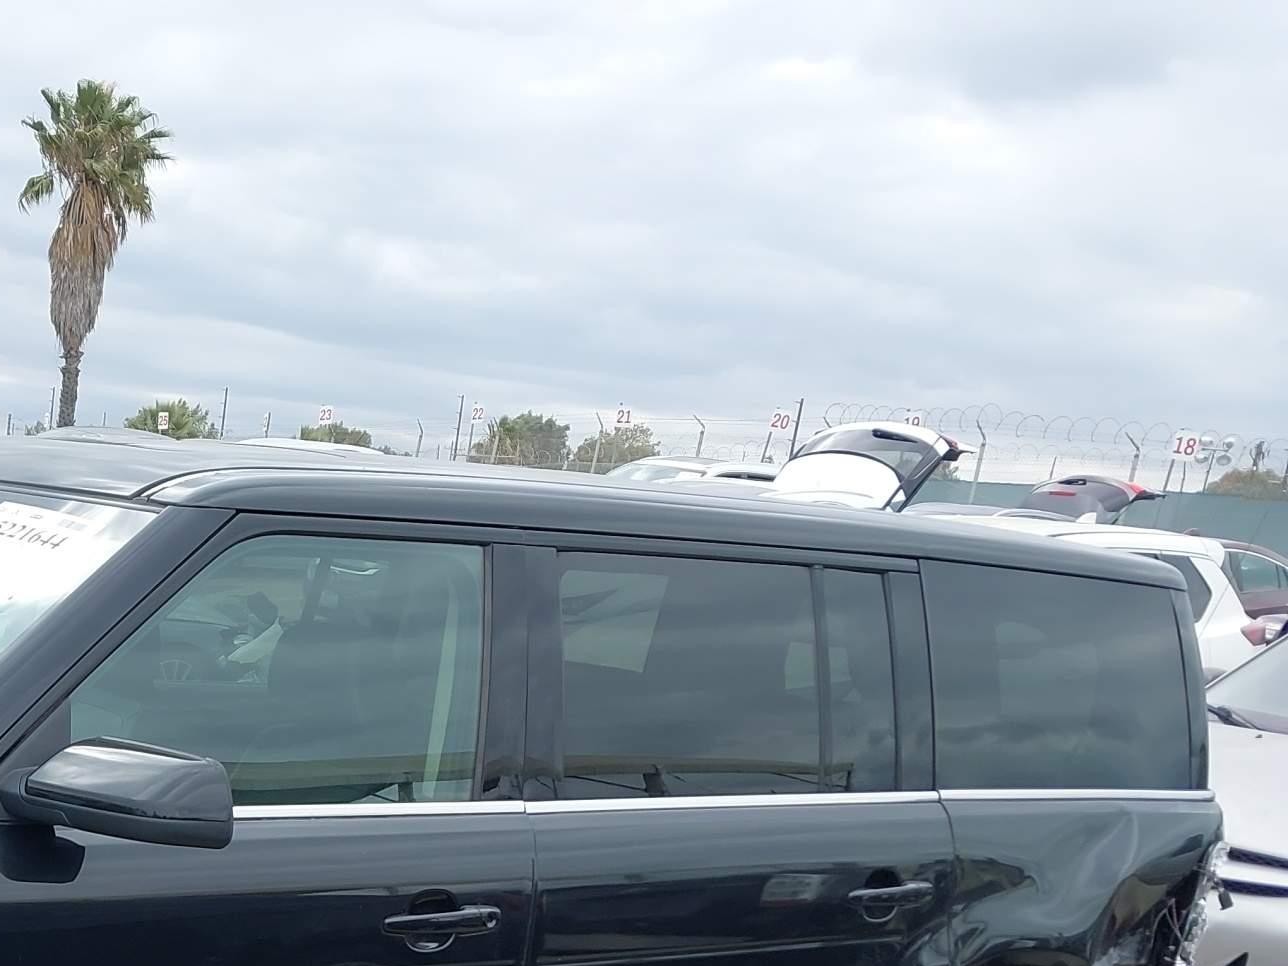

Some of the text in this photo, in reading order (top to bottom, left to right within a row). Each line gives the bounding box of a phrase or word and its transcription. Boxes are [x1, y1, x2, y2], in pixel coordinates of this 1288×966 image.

[320, 409, 332, 420] 23
[472, 407, 484, 420] 22
[617, 410, 631, 423] 21
[771, 413, 790, 429] 20
[1173, 437, 1197, 455] 18
